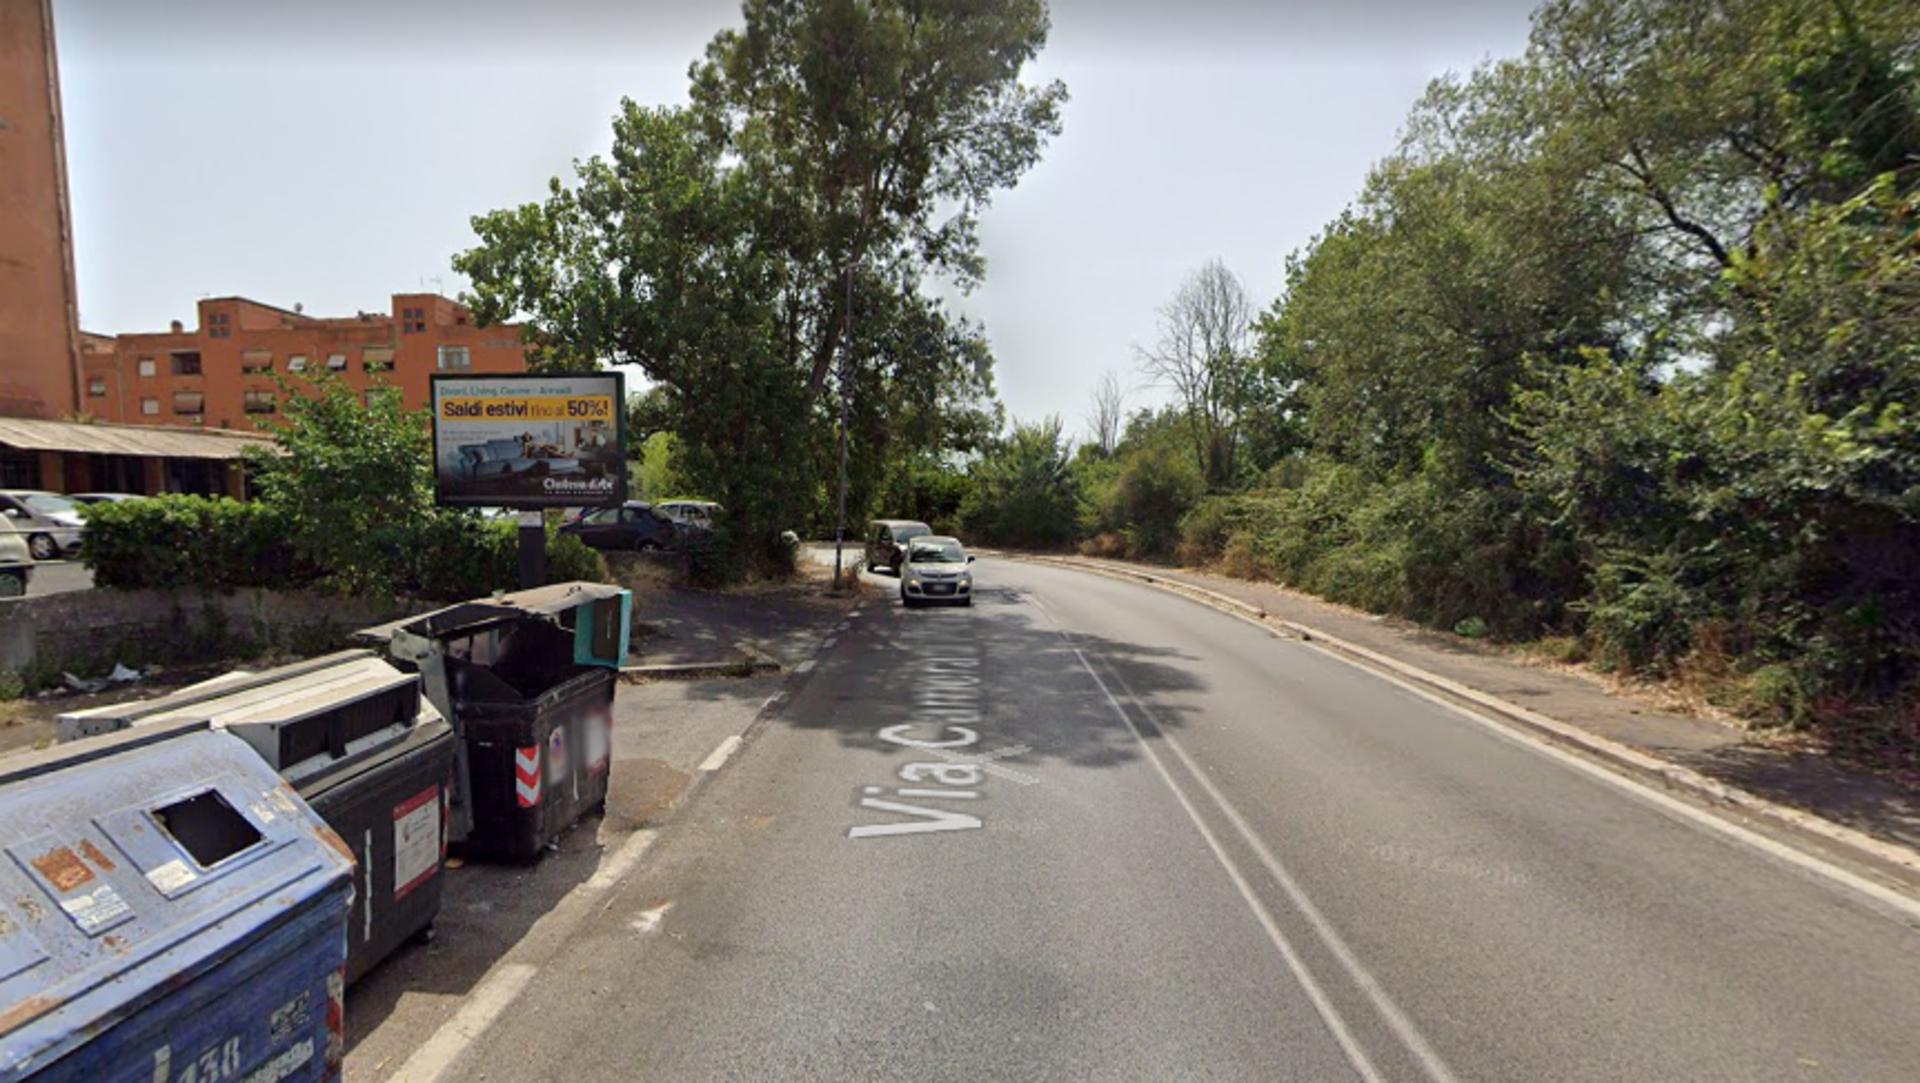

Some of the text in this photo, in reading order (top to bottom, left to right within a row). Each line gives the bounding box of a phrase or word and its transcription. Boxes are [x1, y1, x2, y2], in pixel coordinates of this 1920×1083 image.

[444, 401, 483, 417] Saldi
[486, 400, 528, 416] estivi
[567, 400, 609, 416] 50%!
